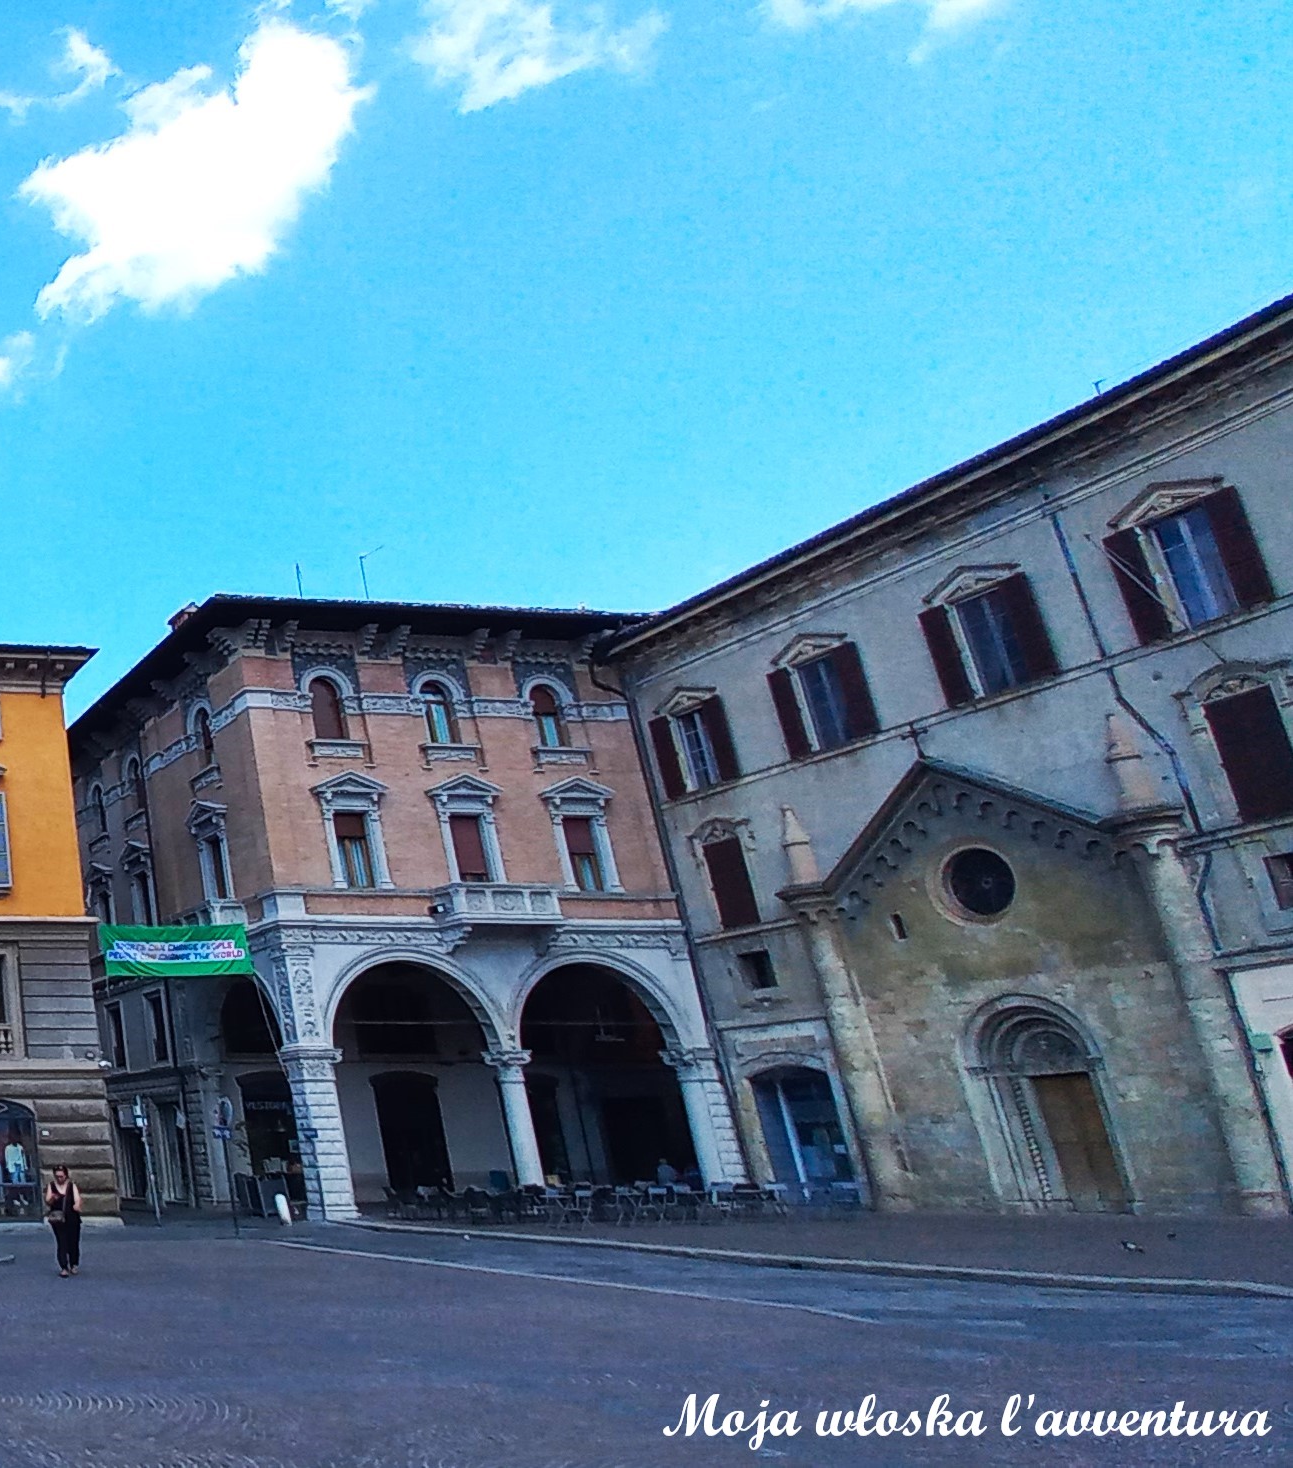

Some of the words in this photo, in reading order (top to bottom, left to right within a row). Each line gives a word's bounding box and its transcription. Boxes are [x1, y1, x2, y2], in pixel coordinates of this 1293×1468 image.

[167, 943, 199, 952] CHANGE
[200, 941, 233, 951] PEOPLE
[158, 952, 191, 961] CHANGE
[193, 952, 211, 960] THE
[212, 949, 243, 959] WORLD
